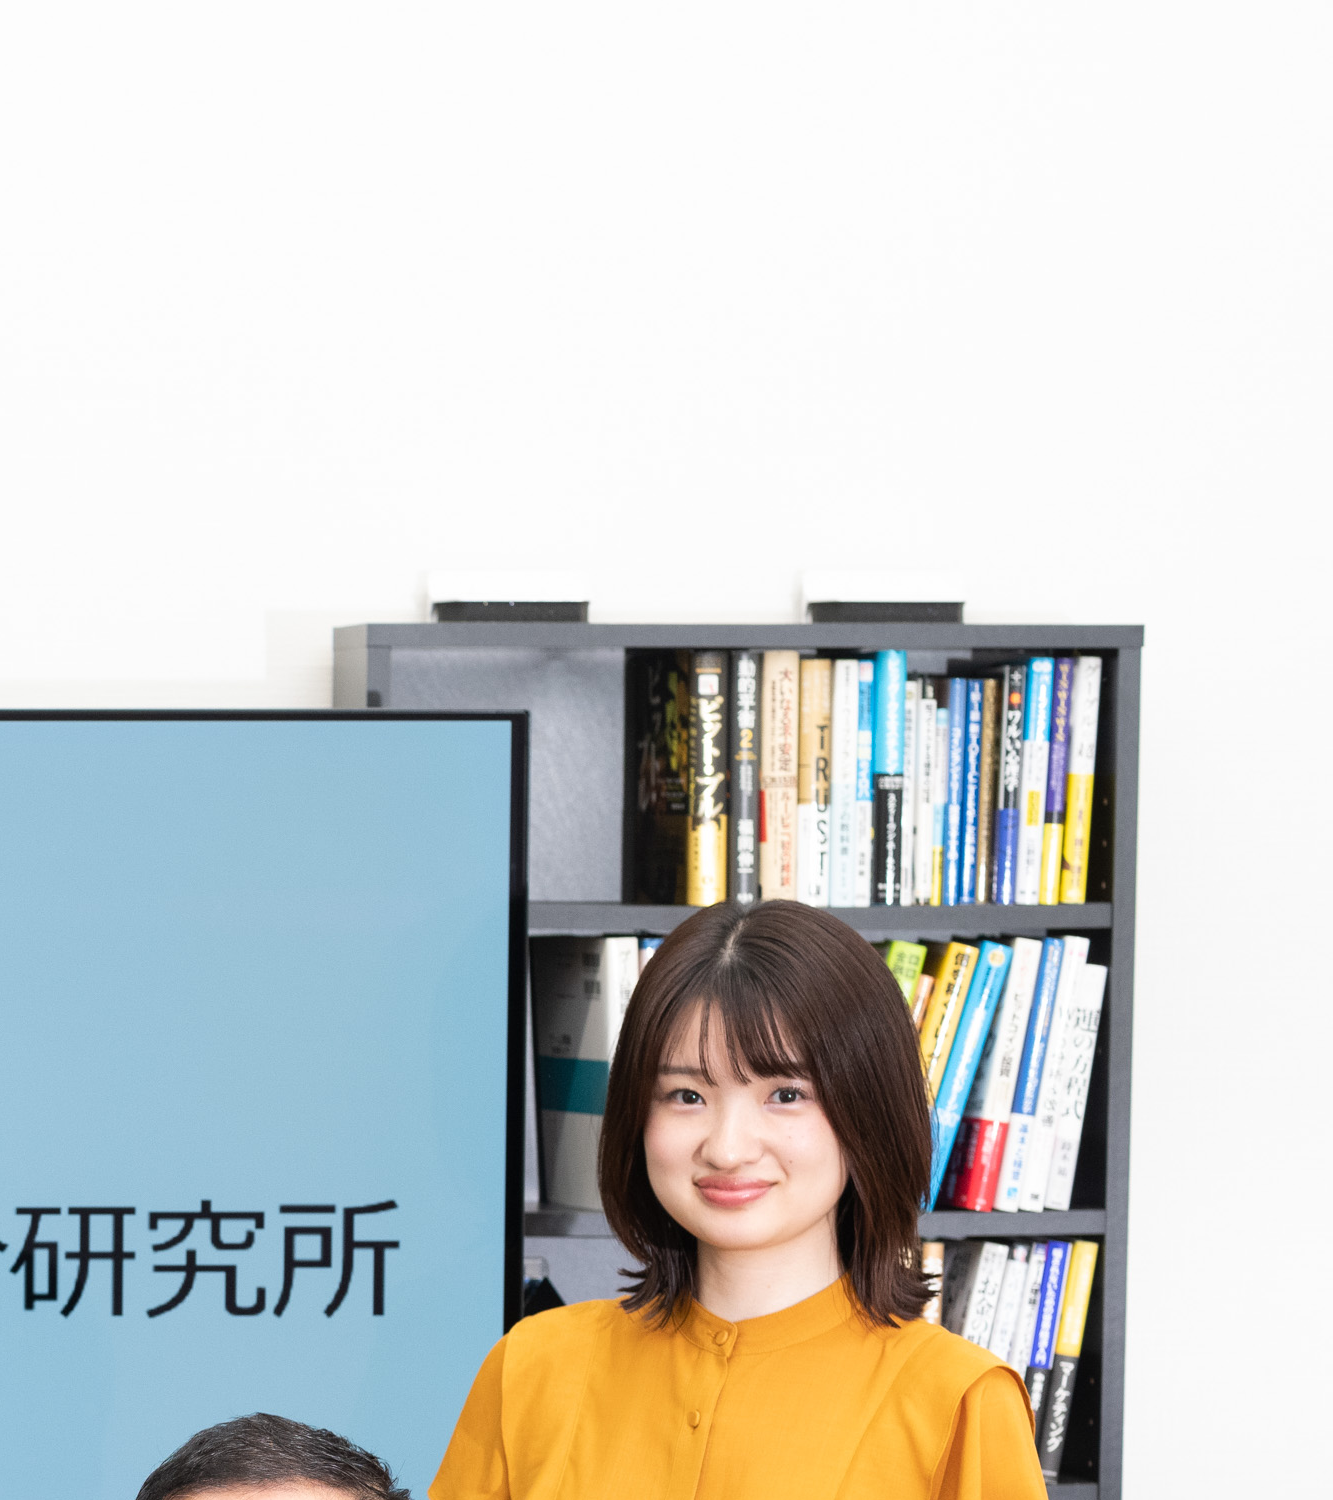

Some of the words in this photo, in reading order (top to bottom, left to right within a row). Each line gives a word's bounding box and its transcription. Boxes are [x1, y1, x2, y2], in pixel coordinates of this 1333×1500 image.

[814, 724, 830, 878] TRUST
[1062, 1006, 1102, 1120] 運の方程式
[1046, 1361, 1075, 1453] マーケティング
